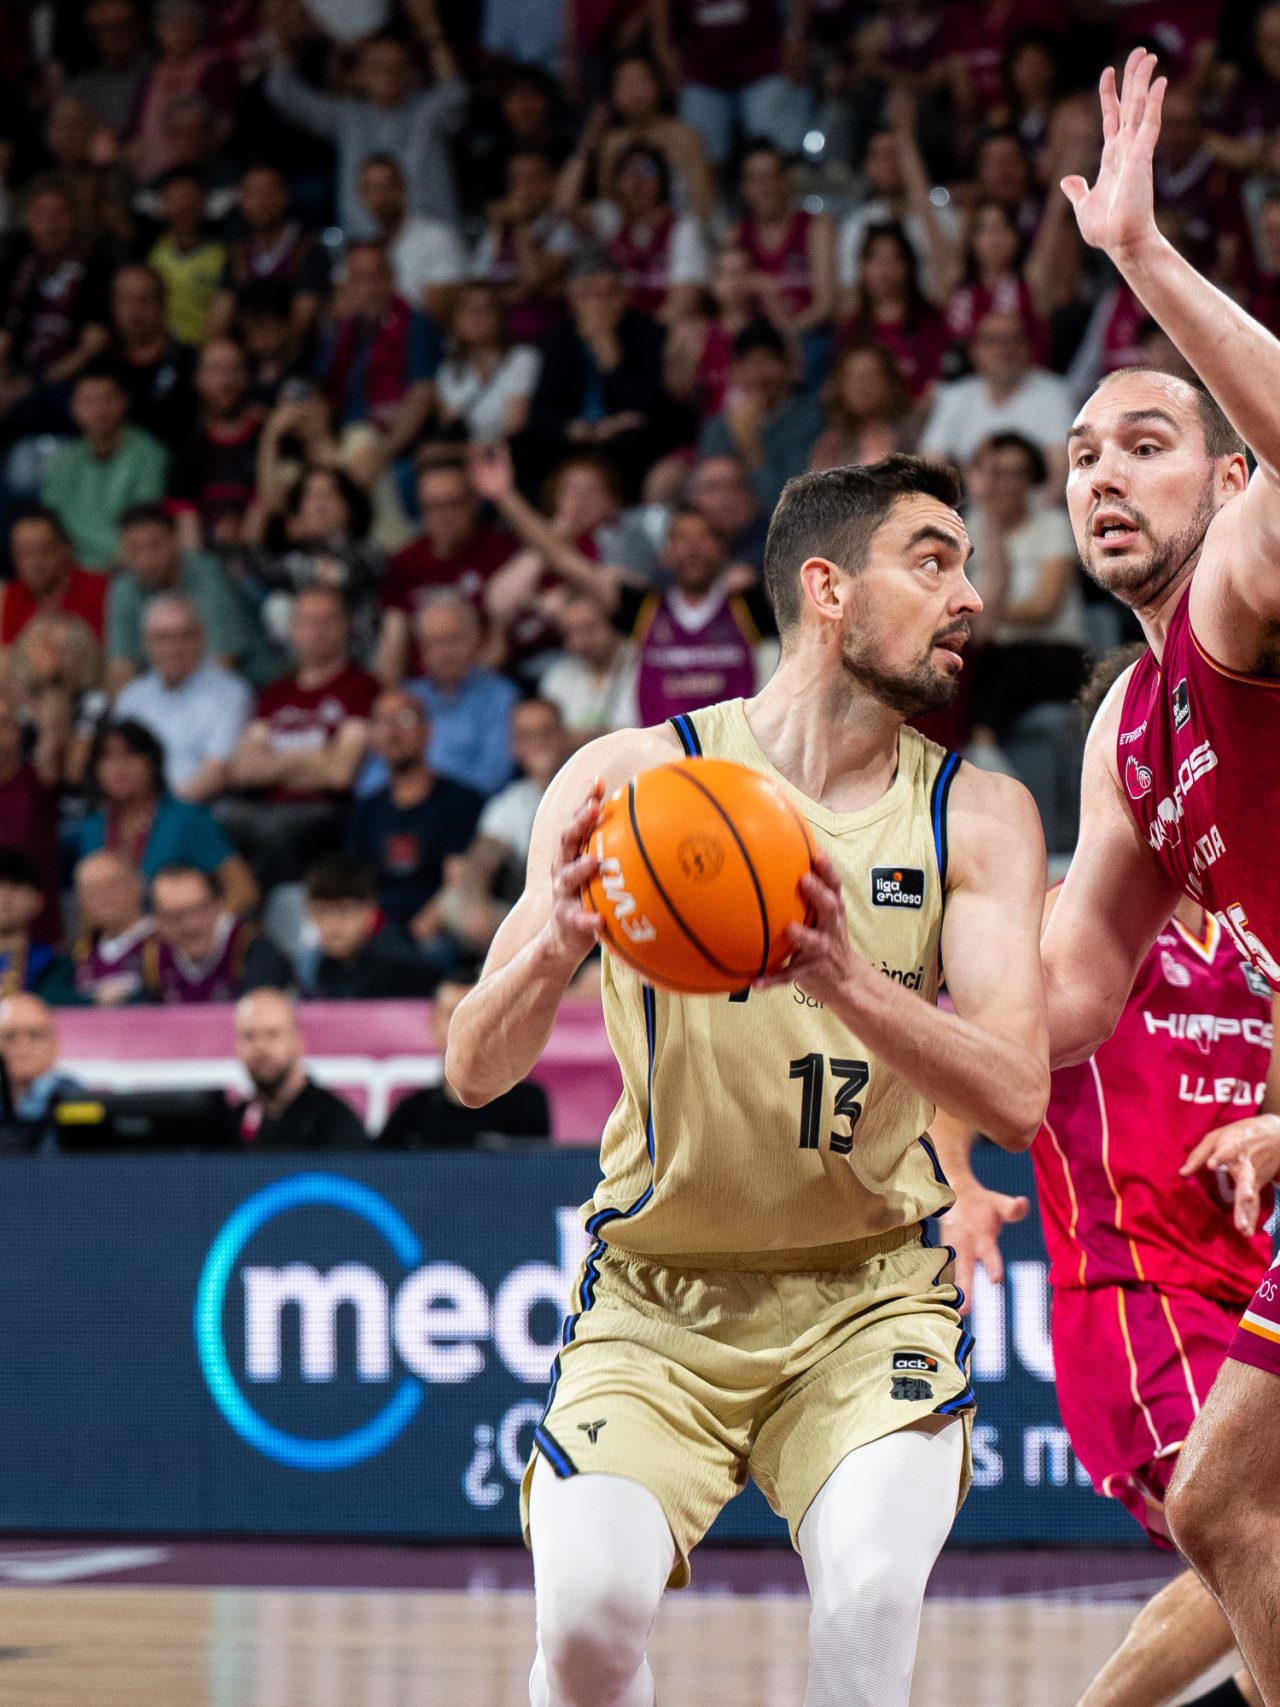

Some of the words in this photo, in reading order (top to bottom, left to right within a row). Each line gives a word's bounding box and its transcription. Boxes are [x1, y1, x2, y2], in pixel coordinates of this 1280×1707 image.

[876, 878, 900, 892] liga
[876, 891, 921, 905] endesa
[789, 1053, 869, 1155] 13
[895, 1359, 929, 1370] acb
